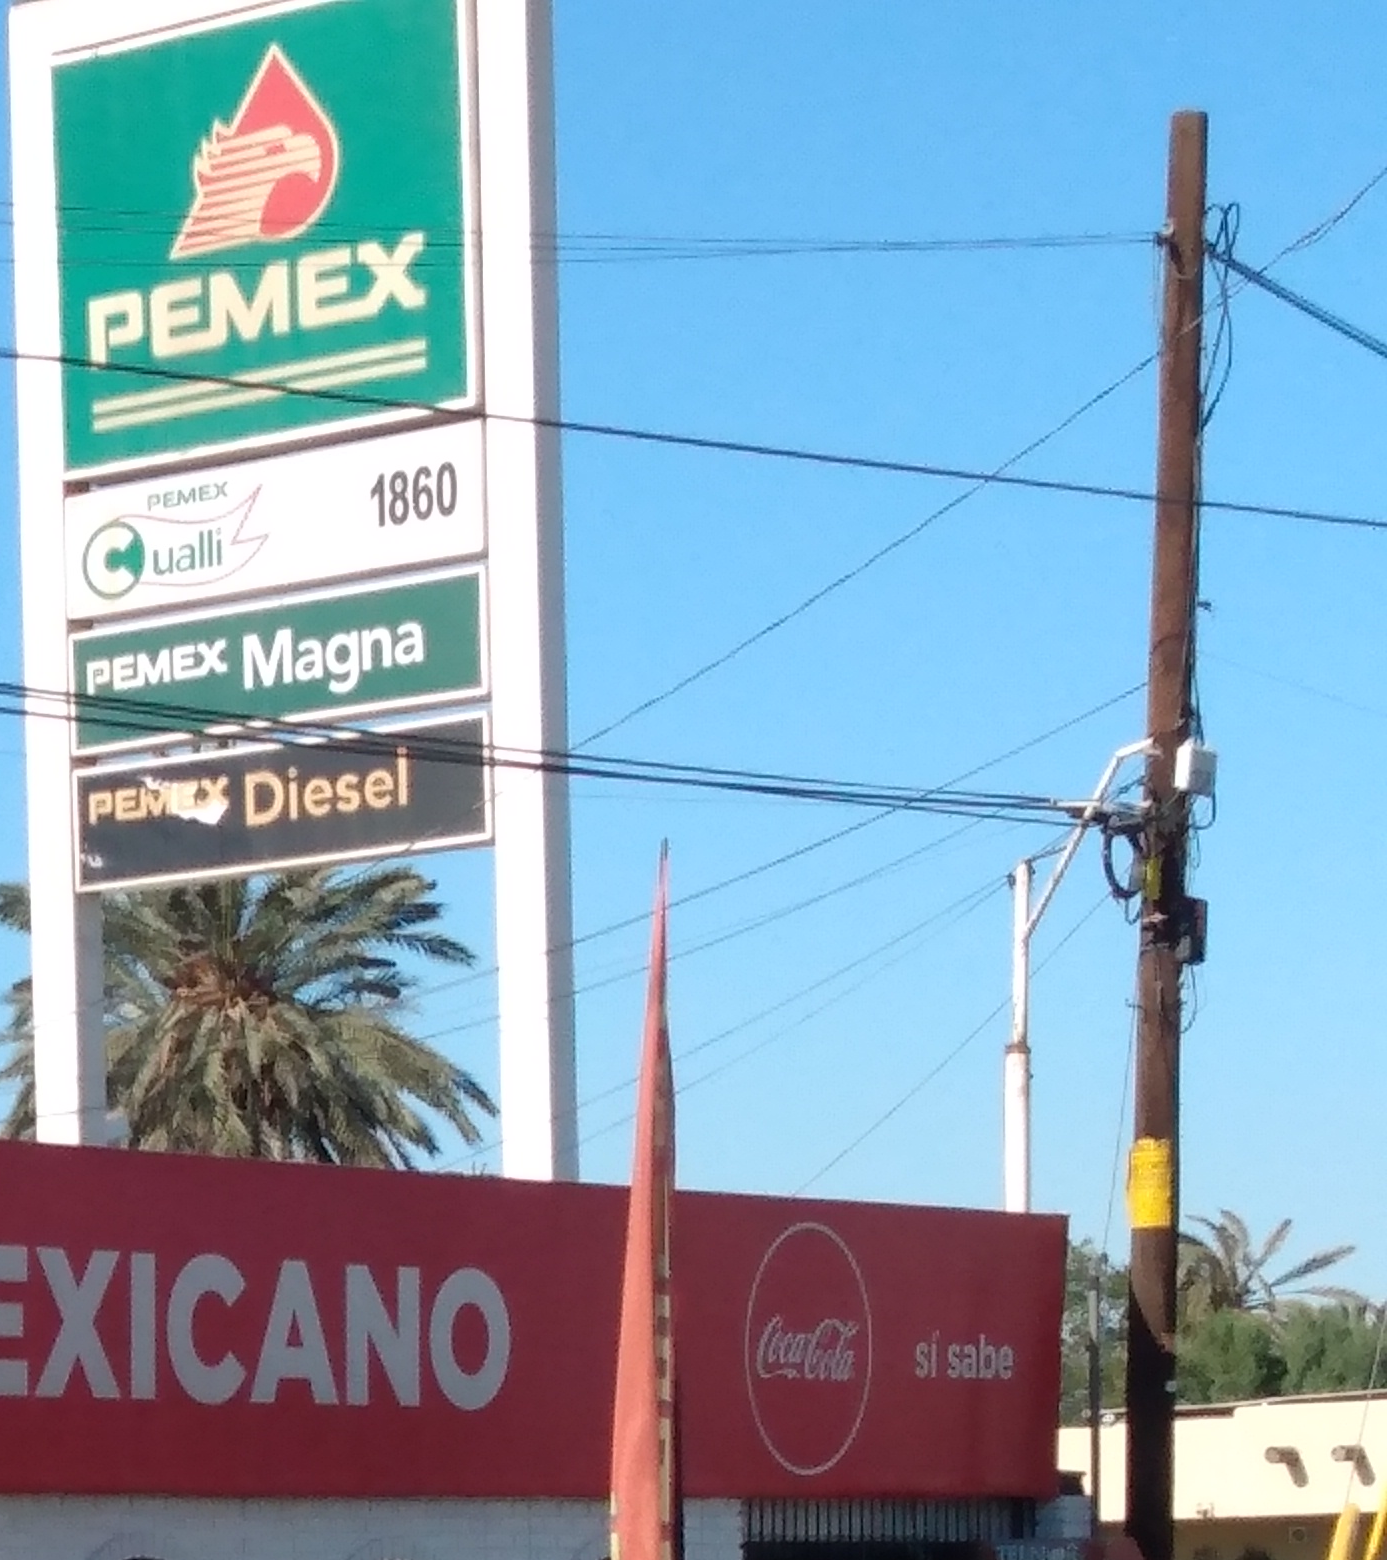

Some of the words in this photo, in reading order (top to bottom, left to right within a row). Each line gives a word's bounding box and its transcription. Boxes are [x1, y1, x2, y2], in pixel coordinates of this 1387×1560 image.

[86, 232, 428, 369] PEMEX
[146, 480, 228, 511] PEMEX
[370, 461, 458, 528] 1860
[82, 520, 224, 600] Cualli
[86, 638, 228, 695] PEMEX
[242, 621, 425, 693] Magna
[88, 774, 230, 826] PEMEX
[244, 746, 409, 829] Diesel
[756, 1313, 859, 1381] Coca-Cola
[947, 1333, 1014, 1380] sabe
